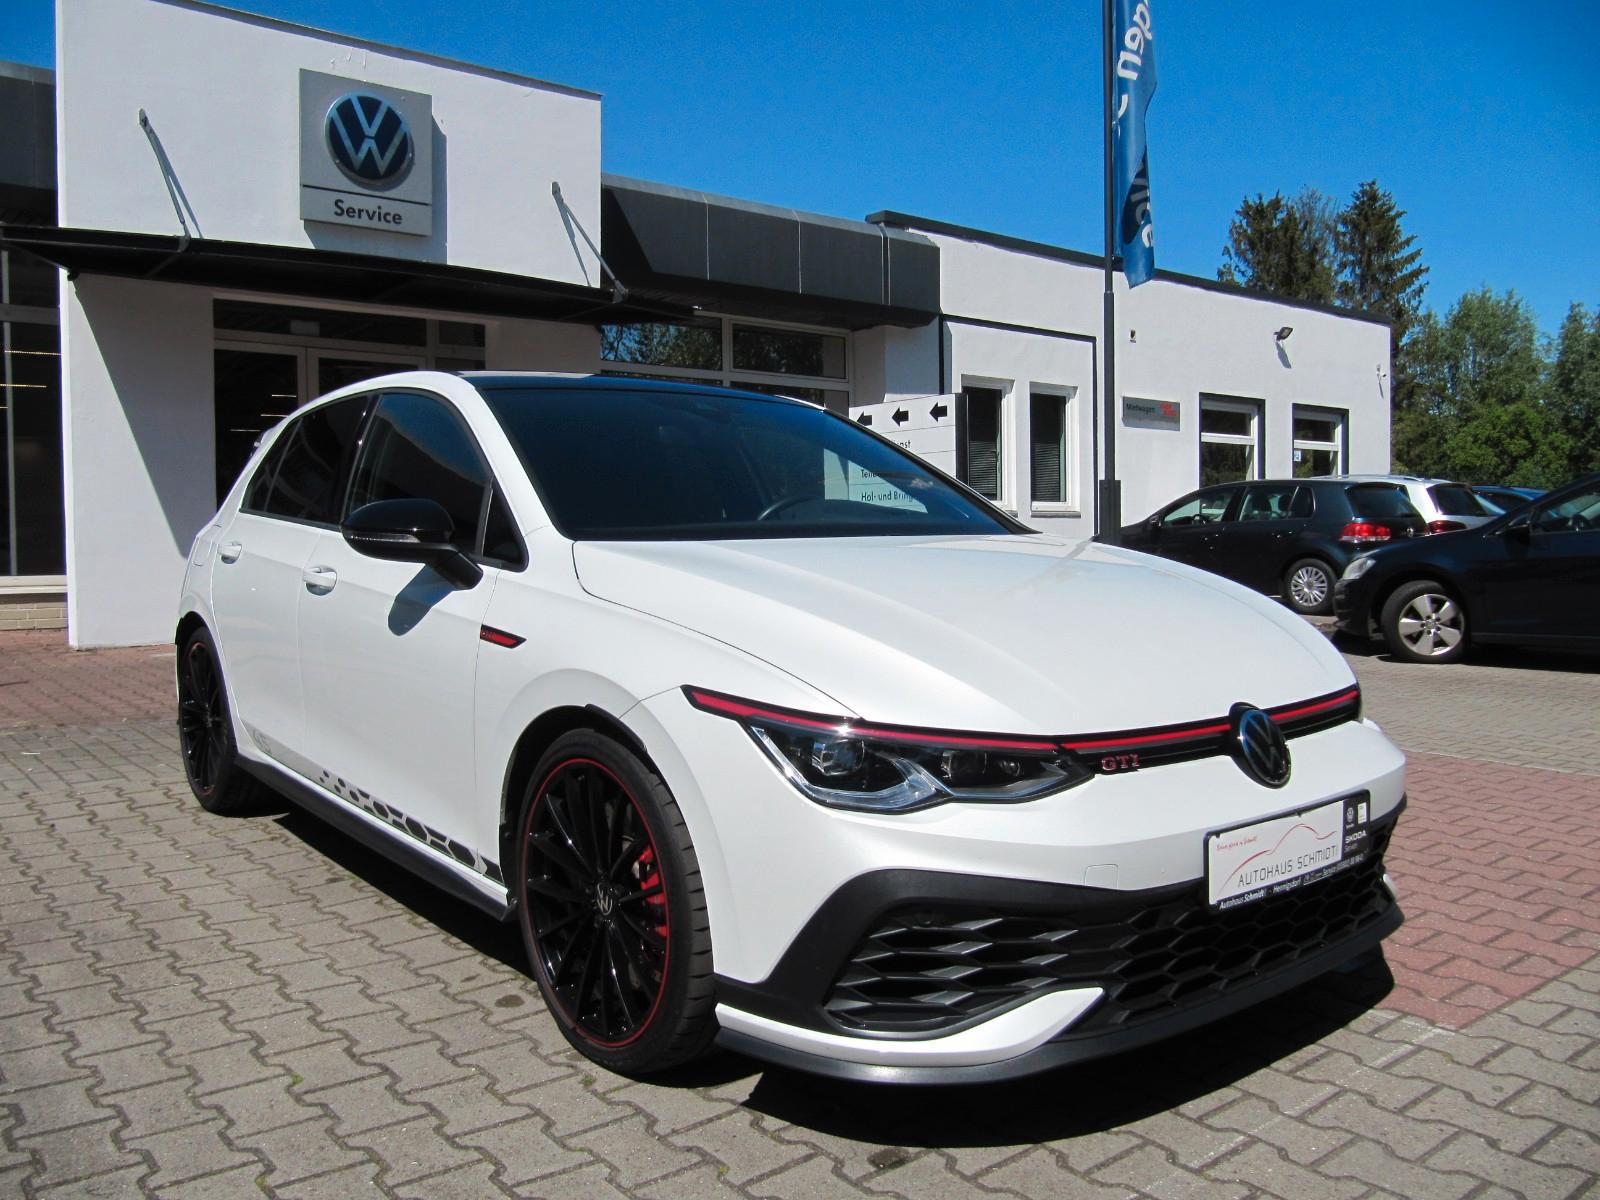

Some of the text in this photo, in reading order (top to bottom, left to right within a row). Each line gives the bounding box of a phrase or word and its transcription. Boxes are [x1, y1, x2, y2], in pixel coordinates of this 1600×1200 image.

[334, 199, 403, 225] Service
[861, 490, 876, 502] Hol-
[878, 490, 892, 501] und
[1101, 754, 1139, 771] GTI
[1238, 859, 1293, 888] AUTOHAUS
[1297, 845, 1337, 870] SCHMIDT
[1243, 888, 1265, 904] Schmidt
